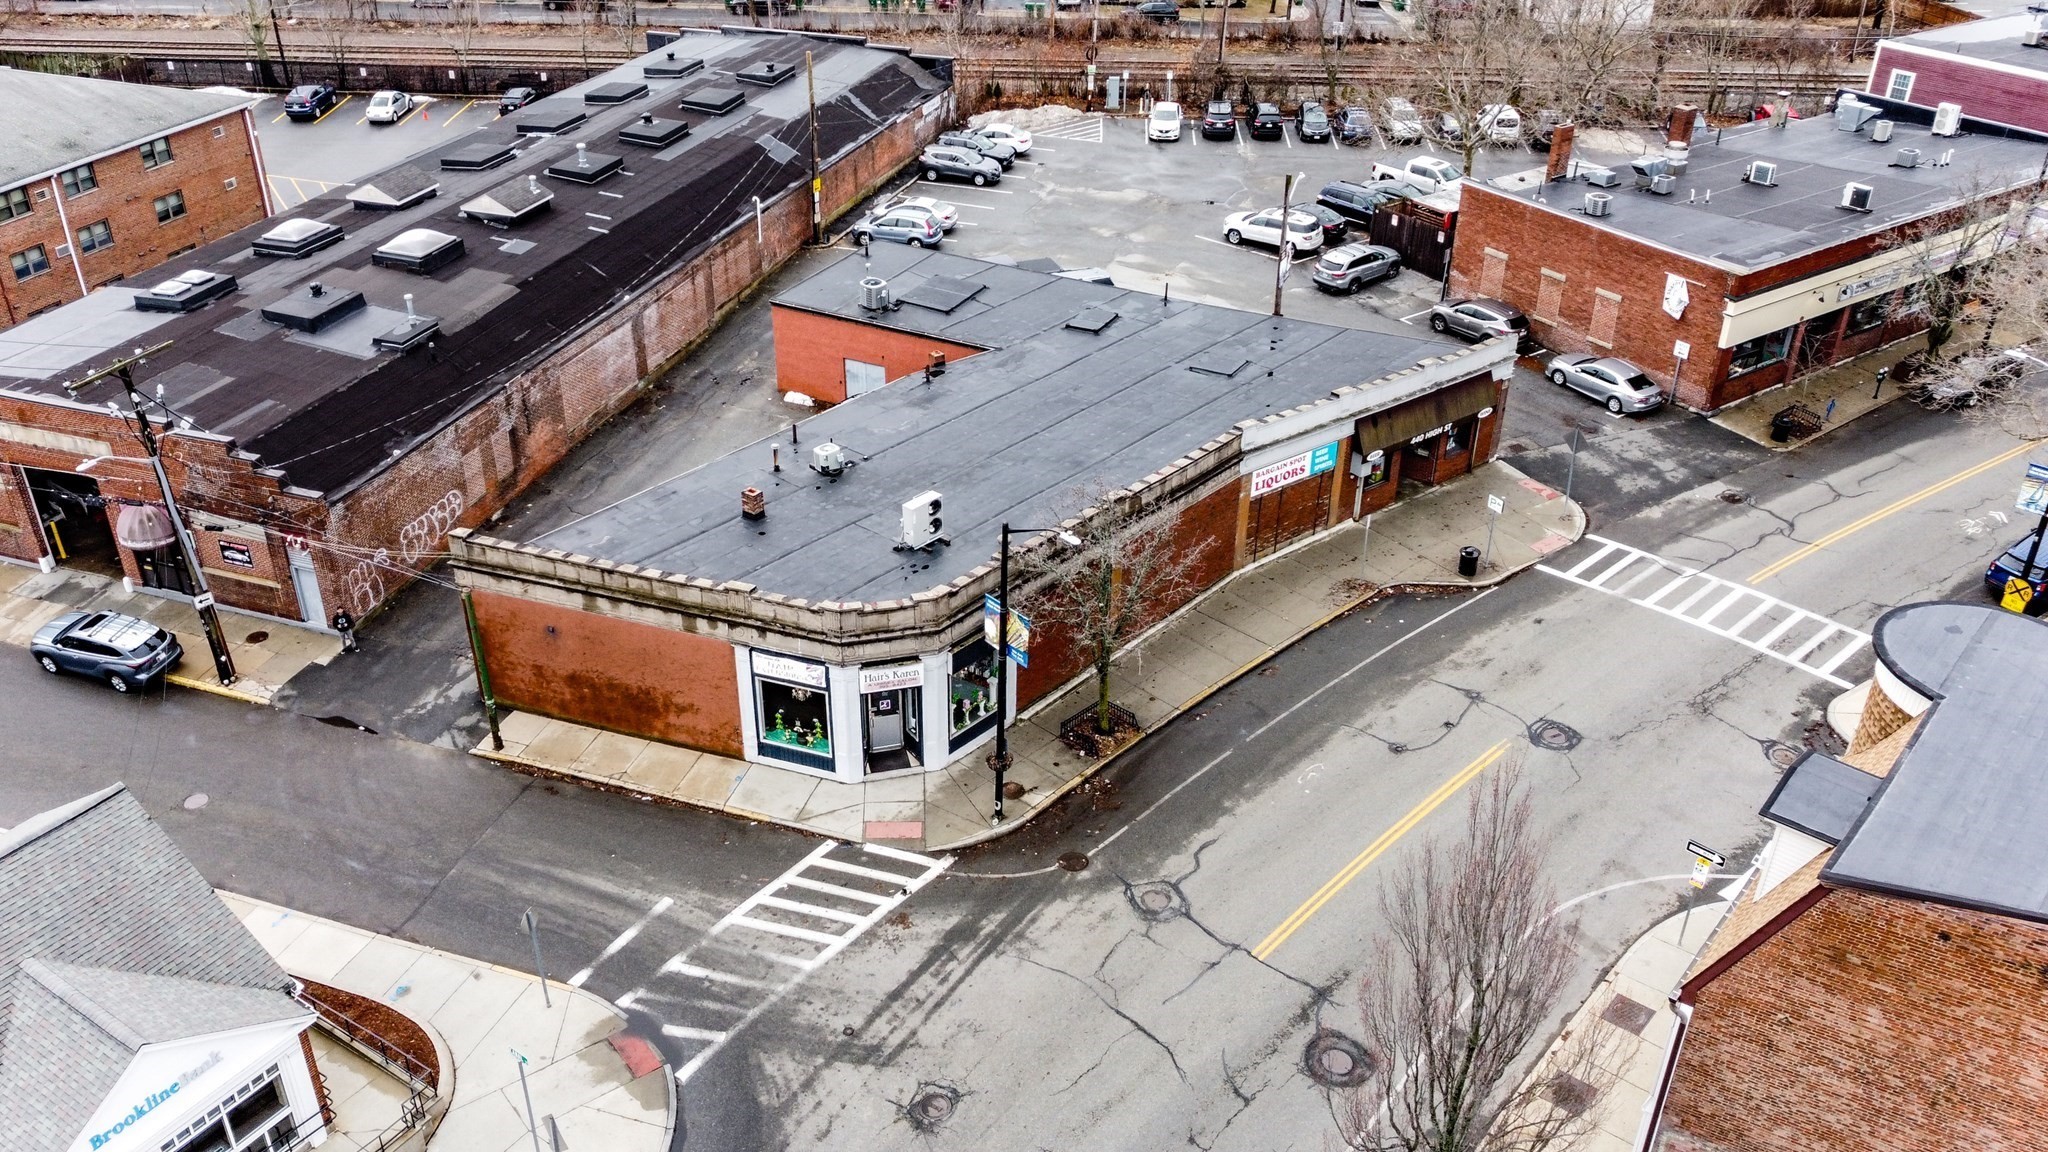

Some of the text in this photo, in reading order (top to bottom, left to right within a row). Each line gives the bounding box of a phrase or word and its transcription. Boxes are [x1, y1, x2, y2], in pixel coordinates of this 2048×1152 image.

[1410, 423, 1453, 444] 440 HIGH ST
[1254, 464, 1306, 492] LIQUORS
[1255, 455, 1308, 479] BARGAIN SPOT
[864, 669, 920, 683] Hair's Karen
